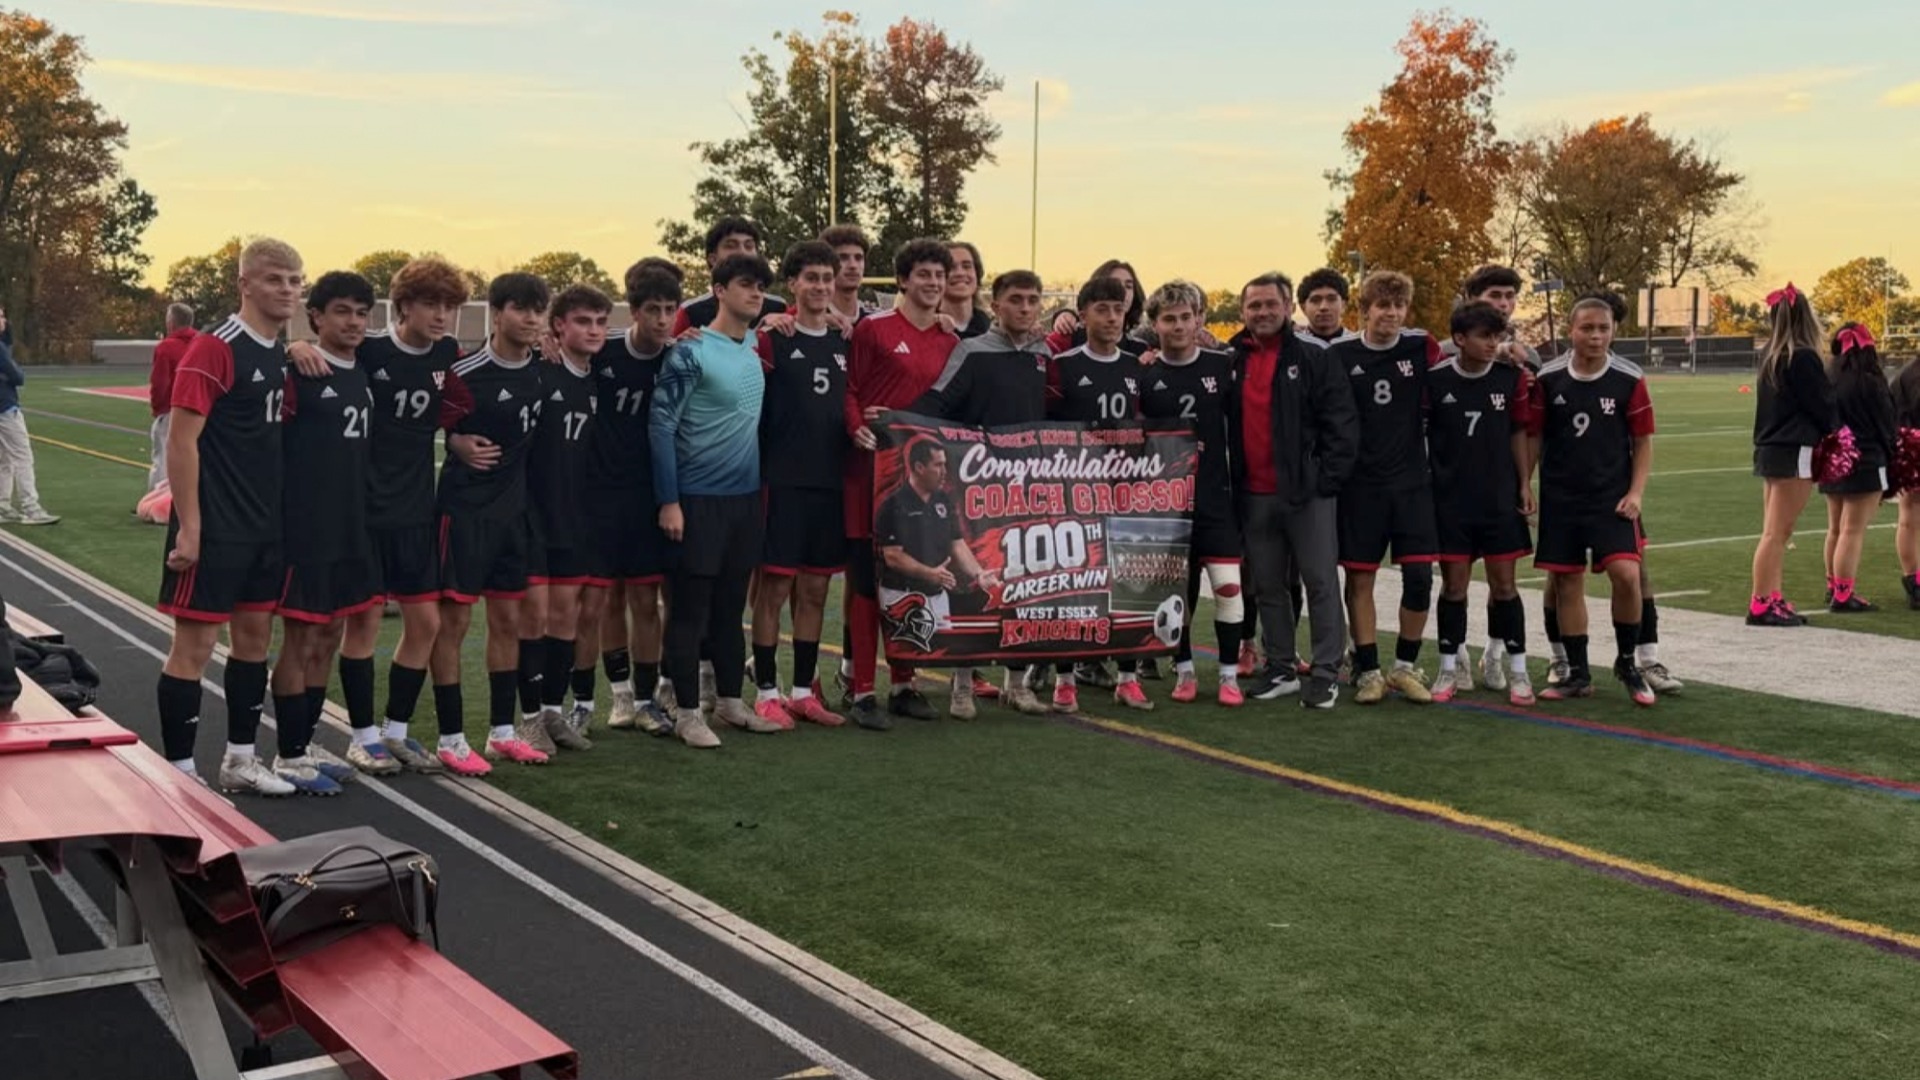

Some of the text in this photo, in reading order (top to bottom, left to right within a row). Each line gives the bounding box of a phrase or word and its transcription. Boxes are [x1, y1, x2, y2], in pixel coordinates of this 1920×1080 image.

[813, 367, 830, 395] 5
[1373, 379, 1393, 405] 8
[393, 389, 431, 419] 19
[615, 387, 644, 415] 11
[1097, 392, 1127, 419] 10
[1178, 394, 1198, 419] 2
[343, 405, 369, 439] 21
[563, 411, 589, 441] 17
[1464, 411, 1482, 437] 7
[1572, 412, 1590, 438] 9
[959, 443, 1165, 485] Congratulations
[964, 475, 1195, 519] COACH GROSSO!
[1001, 568, 1109, 604] CAREER WIN
[1016, 605, 1098, 620] WEST ESSEX
[1000, 618, 1110, 648] KNIGHTS
